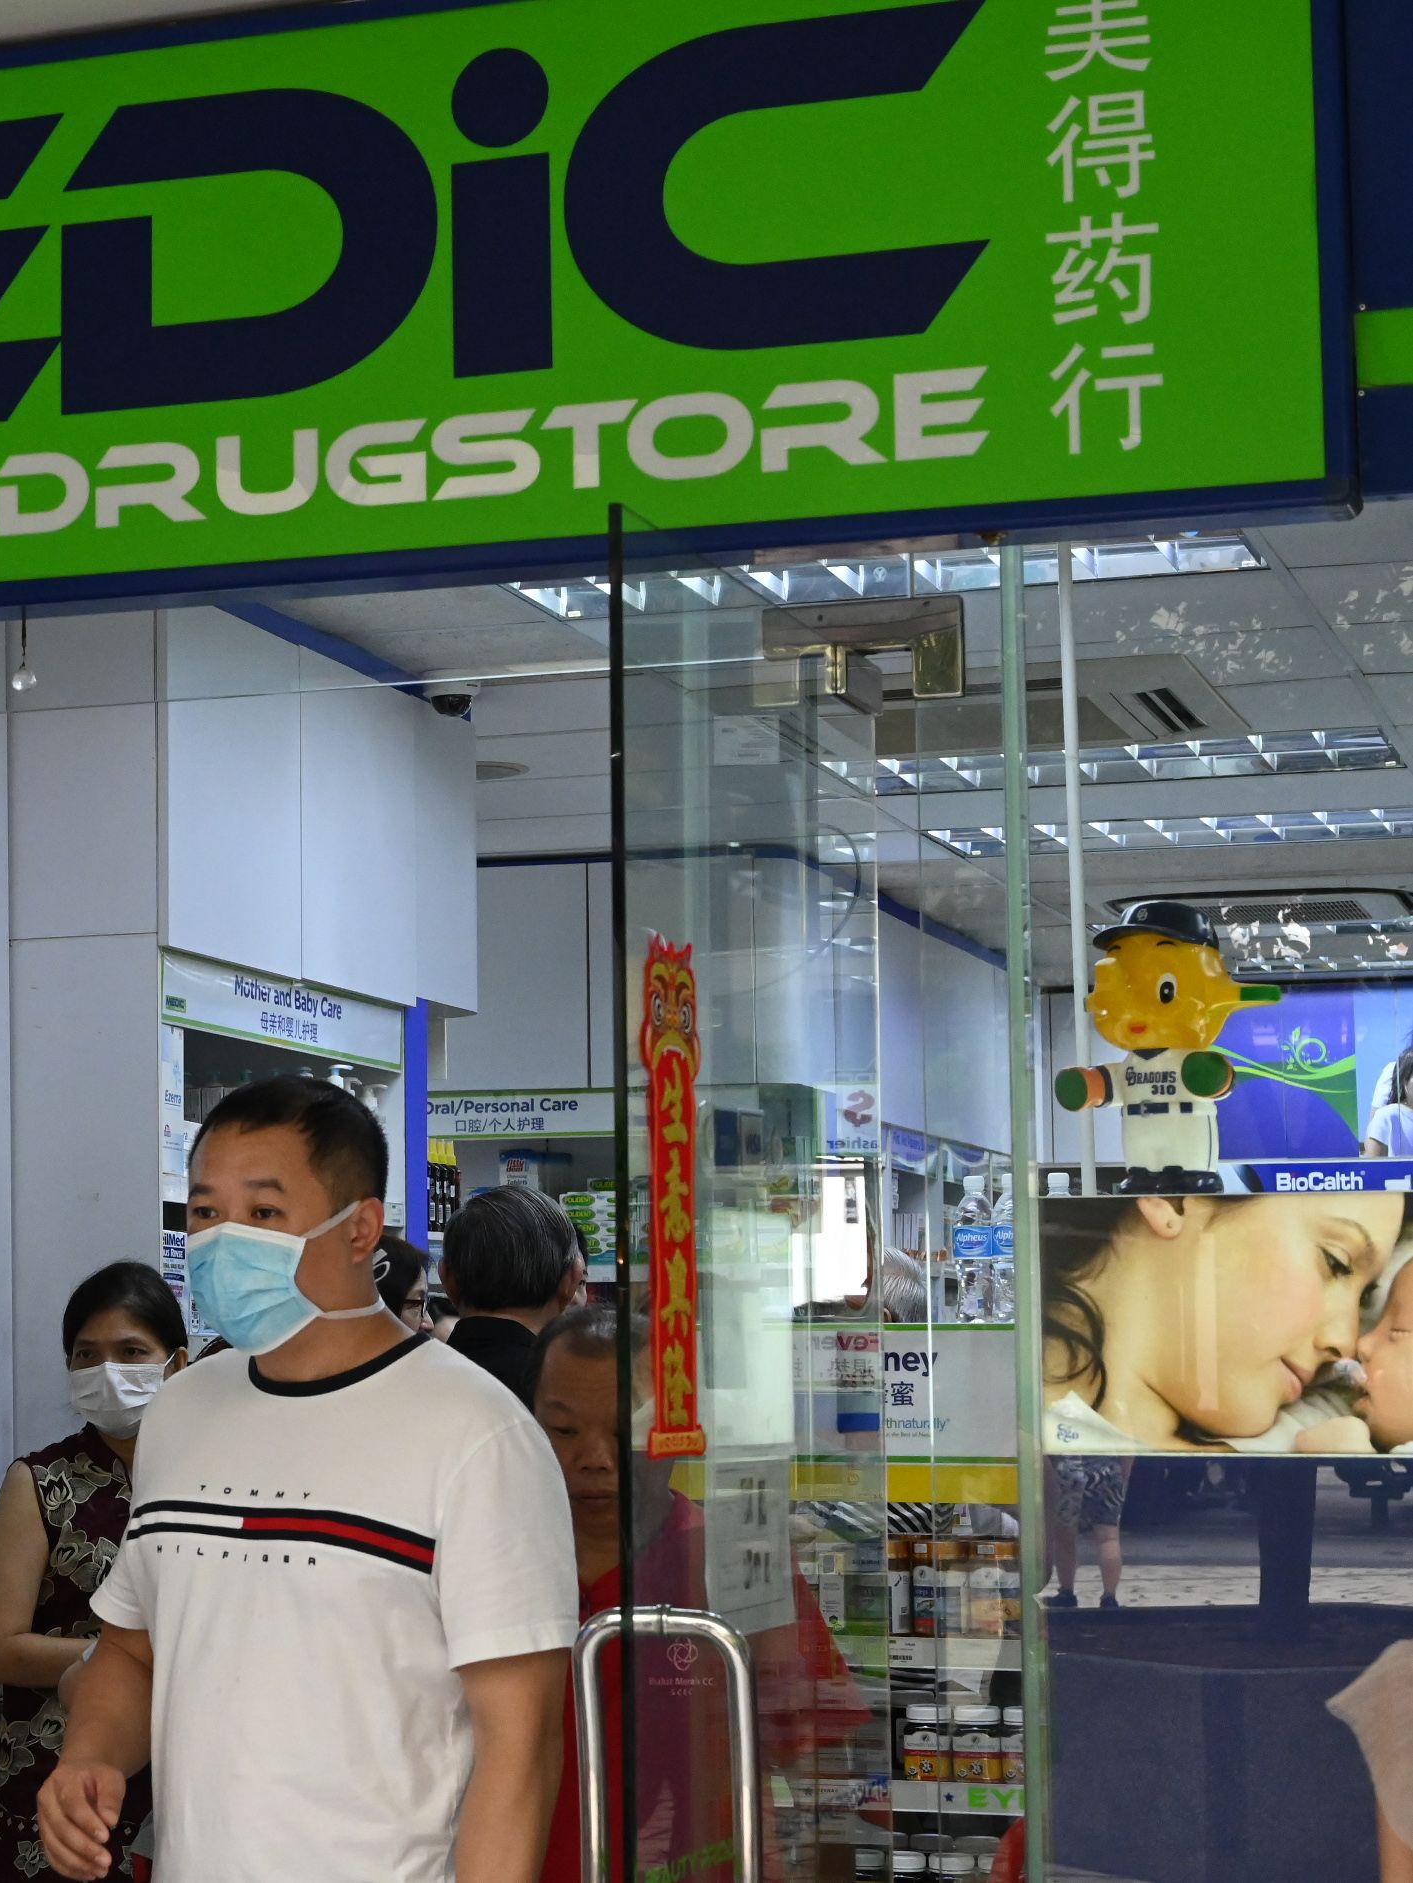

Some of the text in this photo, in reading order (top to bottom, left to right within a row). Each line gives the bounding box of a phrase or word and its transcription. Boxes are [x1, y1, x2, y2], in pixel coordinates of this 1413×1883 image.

[1044, 0, 1165, 455] 美得药行
[234, 975, 342, 1020] Mother and Baby Care
[260, 1011, 318, 1043] 母亲和婴儿护理
[1151, 1084, 1176, 1096] 310
[540, 1098, 578, 1112] Care
[455, 1117, 545, 1133] 口腔/个人护理
[1276, 1171, 1363, 1191] BioCalth
[956, 1232, 988, 1245] Alpheus
[884, 1381, 914, 1406] 蜜
[199, 1484, 310, 1500] TOMMY
[156, 1544, 316, 1566] HILFIGER
